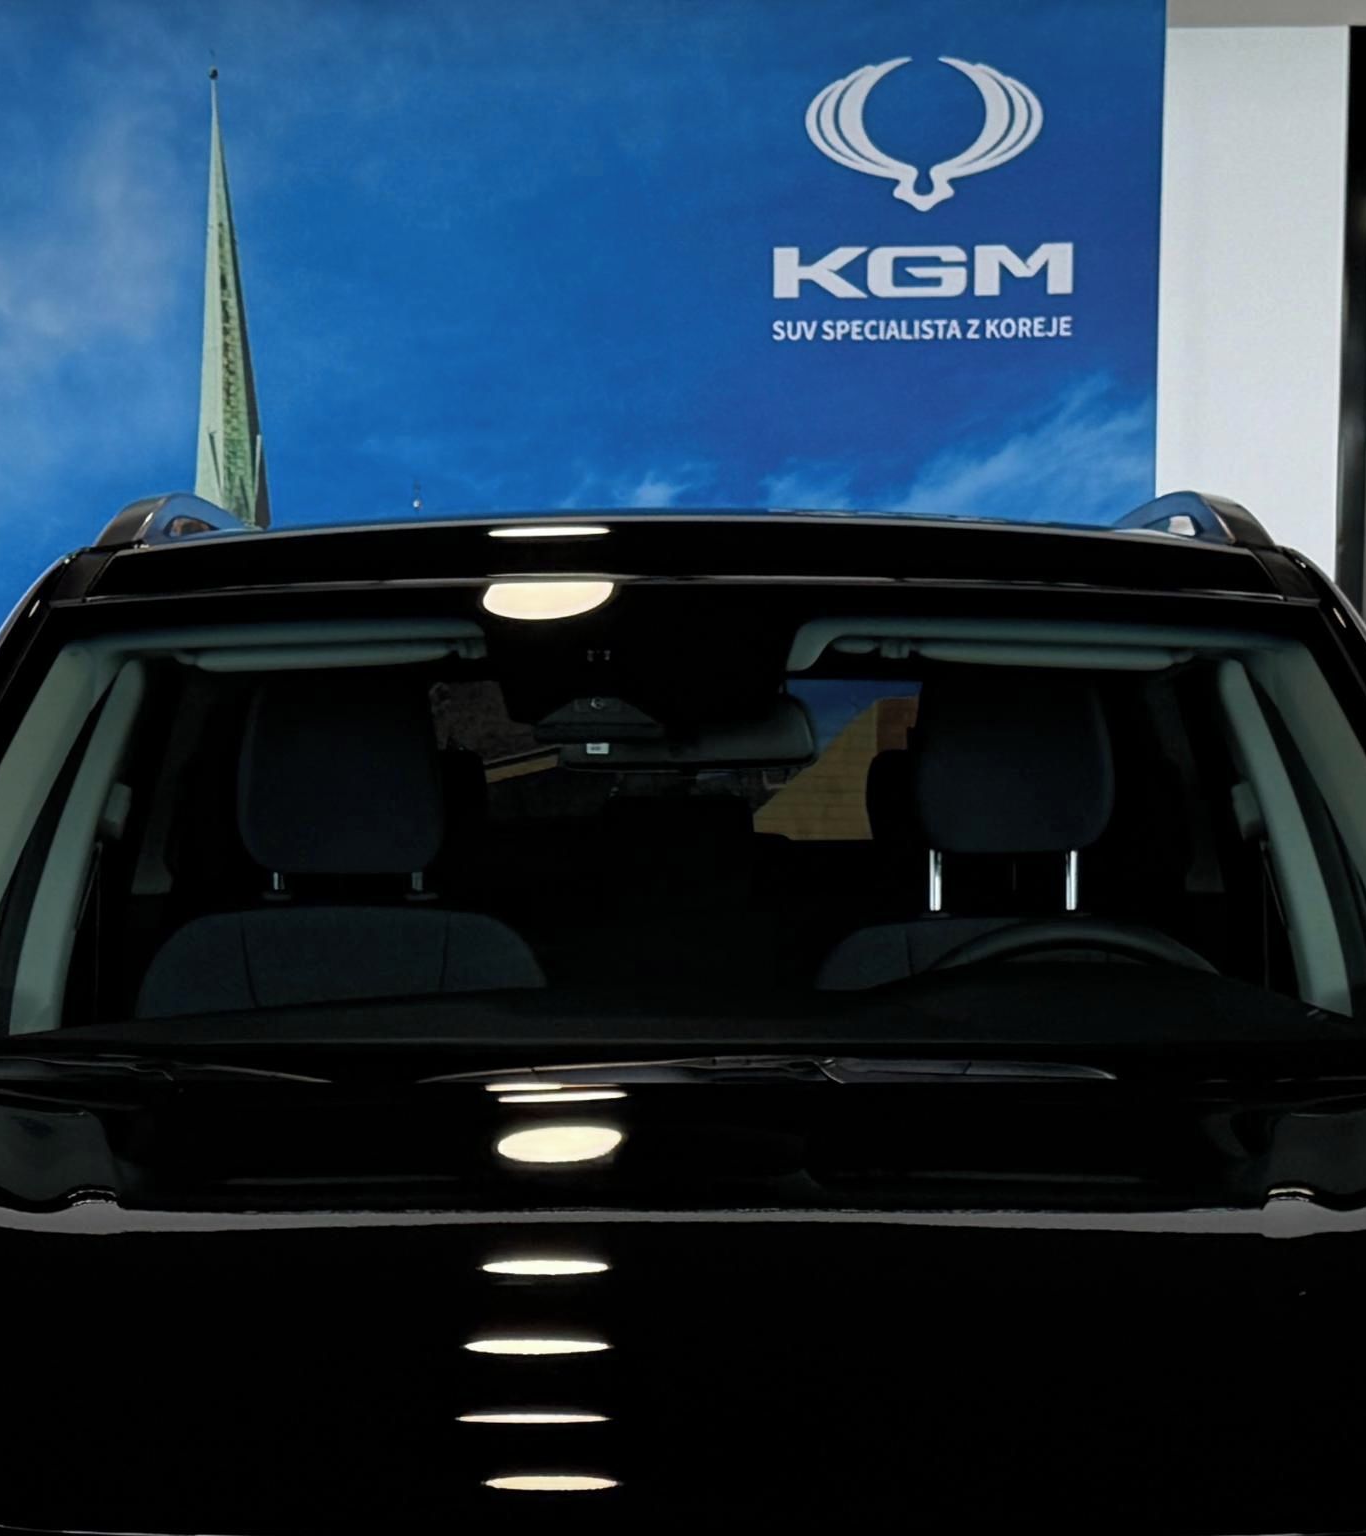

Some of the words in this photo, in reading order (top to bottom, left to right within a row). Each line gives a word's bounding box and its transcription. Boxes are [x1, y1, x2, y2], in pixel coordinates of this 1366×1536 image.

[773, 242, 1073, 299] KGM
[772, 319, 818, 341] SUV
[821, 319, 962, 341] SPECIALISTA
[966, 318, 980, 340] Z
[985, 315, 1073, 339] KOREJE
